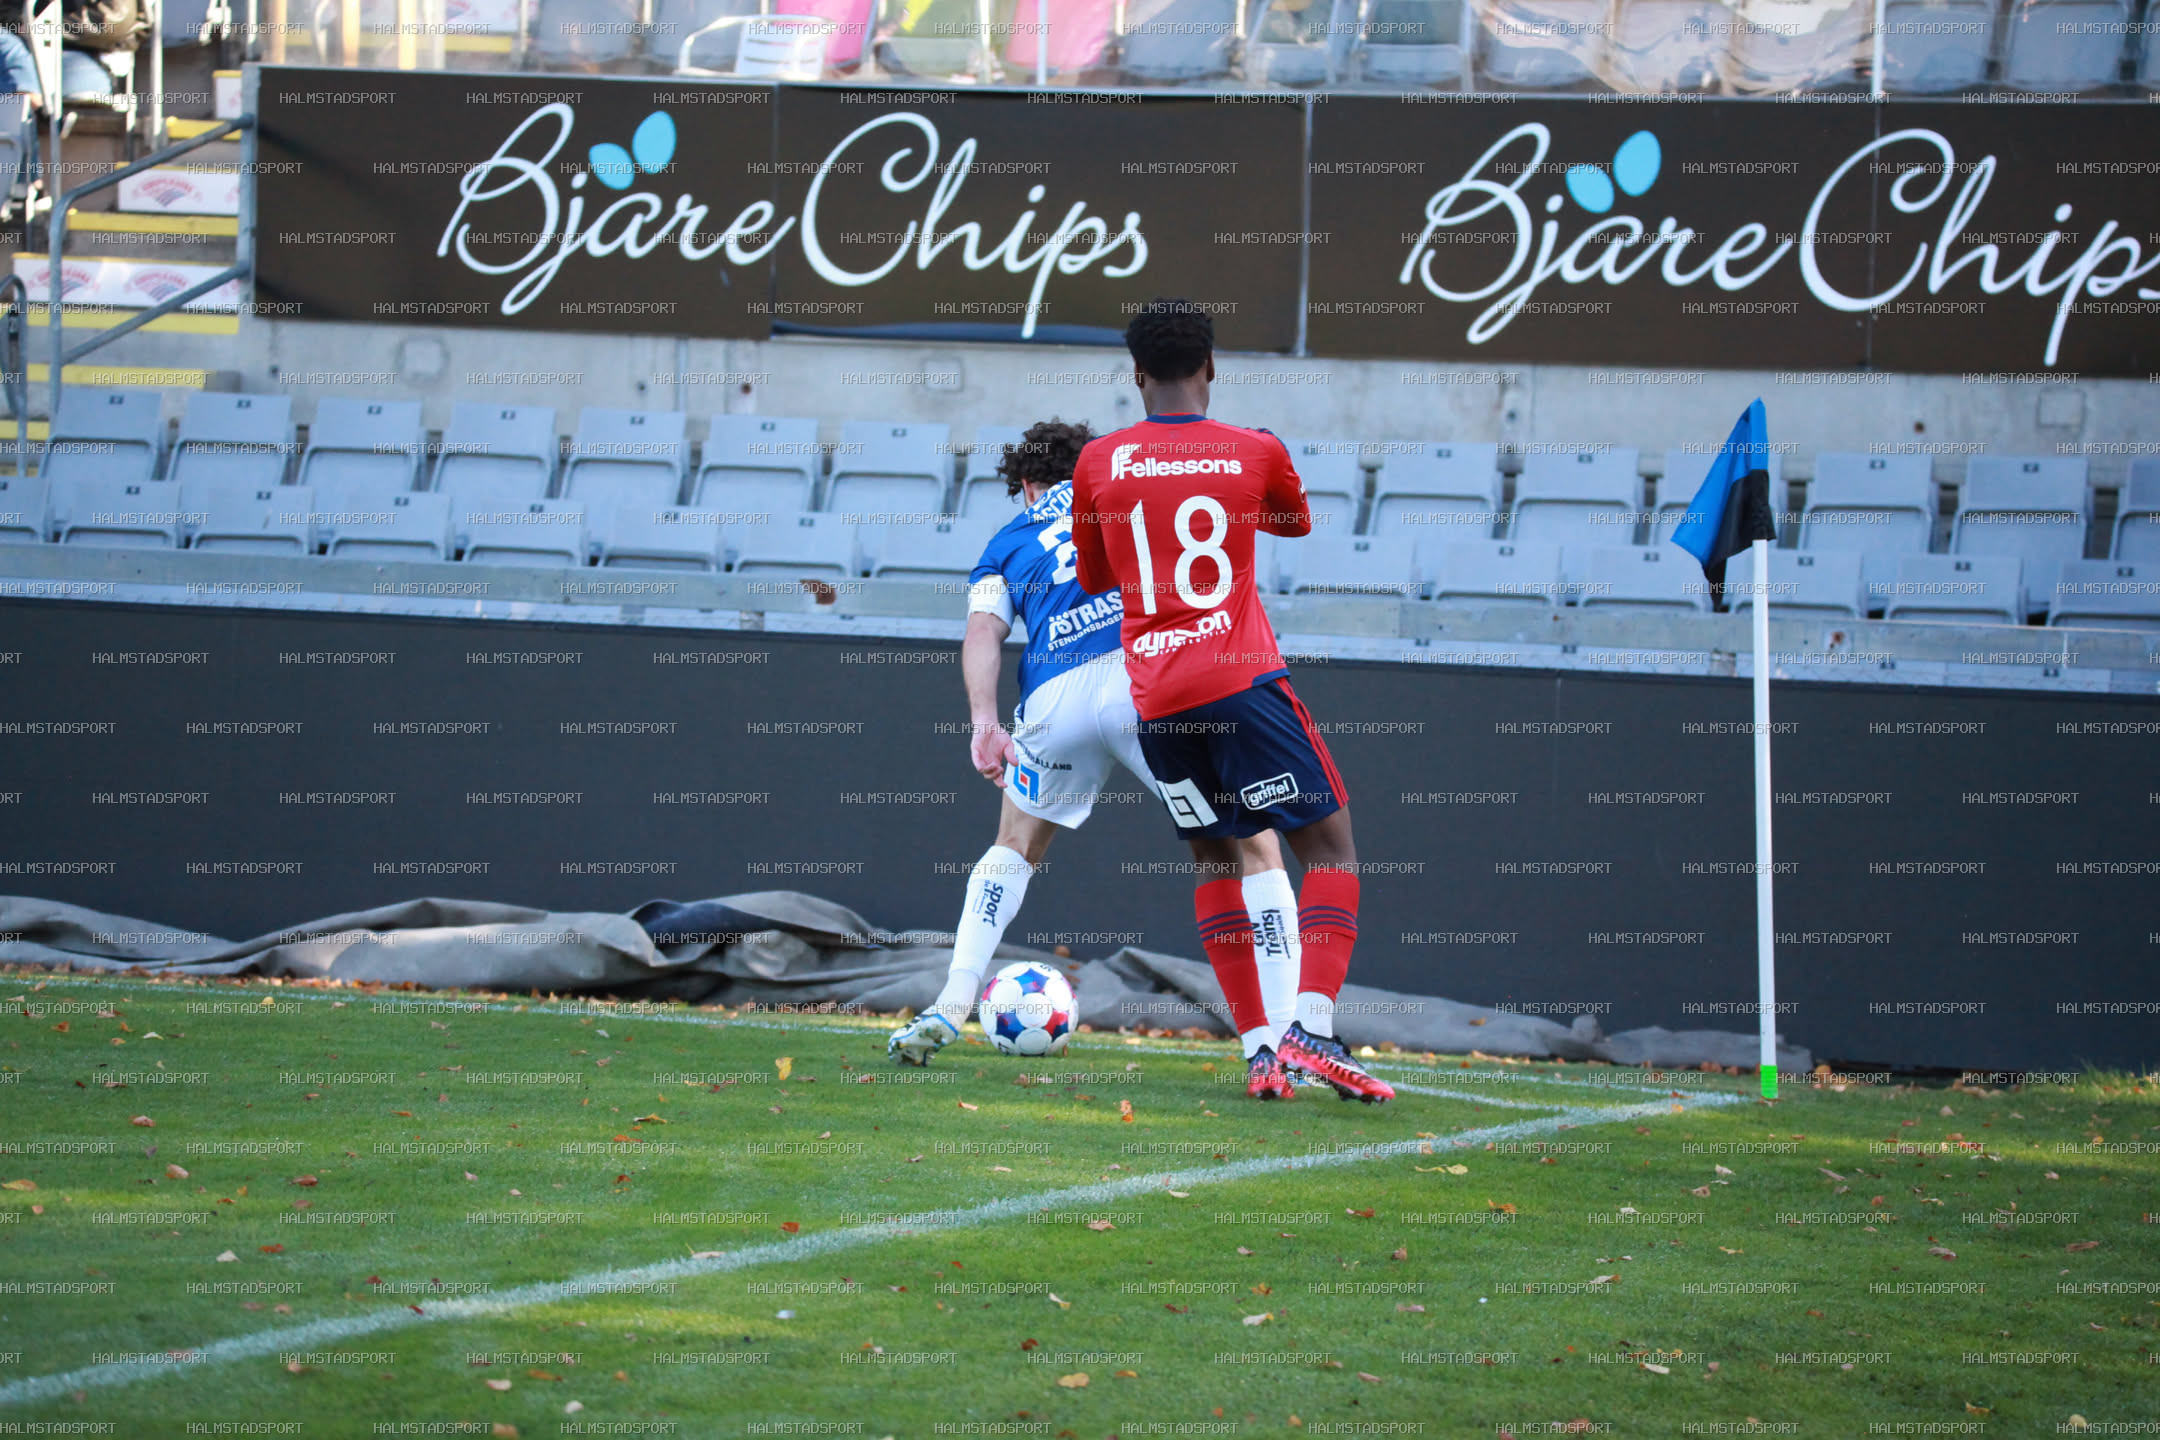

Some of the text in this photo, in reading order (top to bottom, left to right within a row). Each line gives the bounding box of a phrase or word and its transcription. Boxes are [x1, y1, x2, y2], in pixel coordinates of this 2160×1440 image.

[801, 112, 1148, 338] Chips
[1117, 457, 1242, 480] Fellessons
[1130, 495, 1233, 615] 18
[1250, 779, 1290, 807] griffel
[983, 883, 1004, 928] sport
